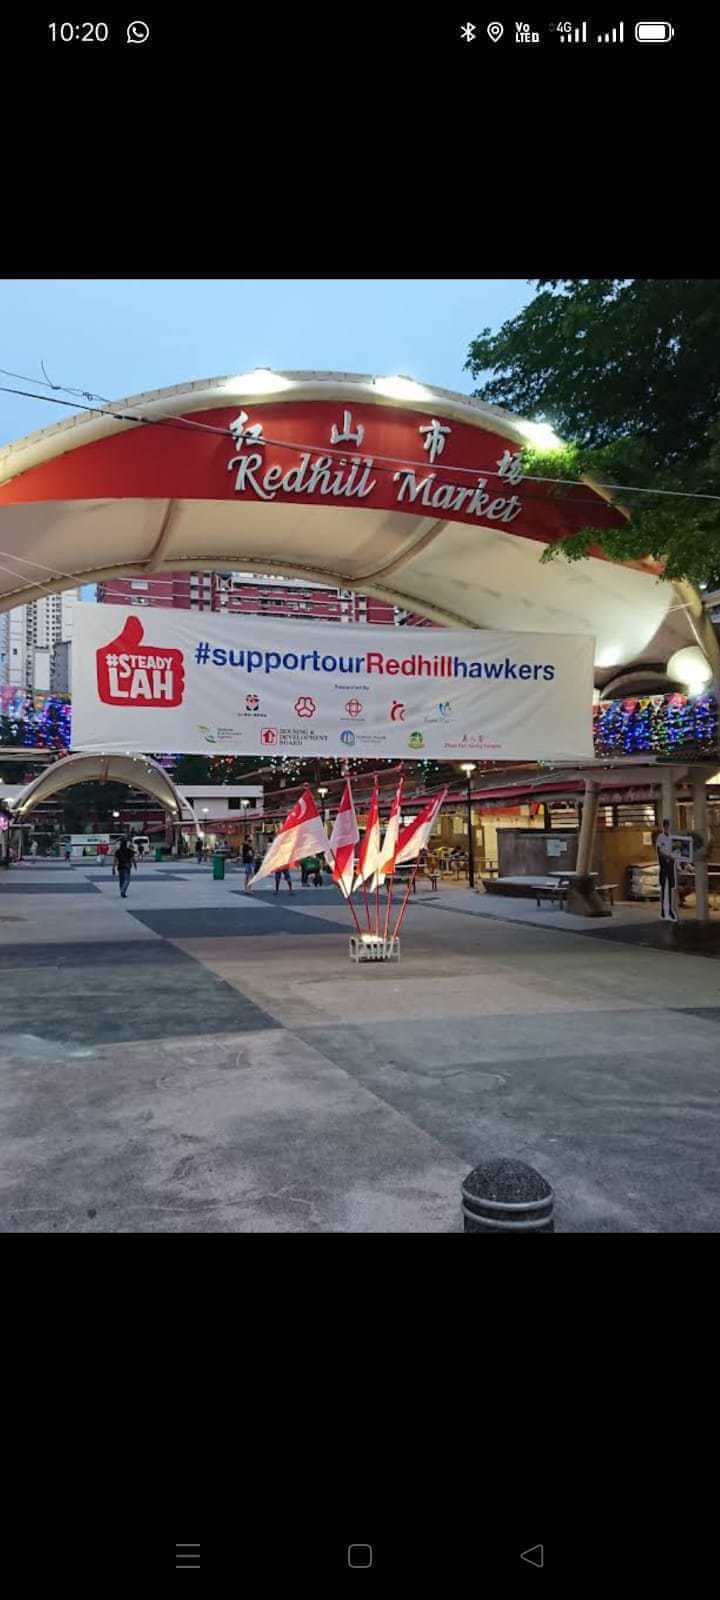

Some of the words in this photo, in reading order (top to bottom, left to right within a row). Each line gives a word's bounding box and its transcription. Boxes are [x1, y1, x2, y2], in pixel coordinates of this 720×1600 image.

[227, 453, 377, 501] Redhill
[393, 468, 524, 523] Market
[105, 653, 174, 679] #STEADY
[194, 641, 556, 681] #supportourRedhillhawkers
[108, 668, 173, 700] LAH
